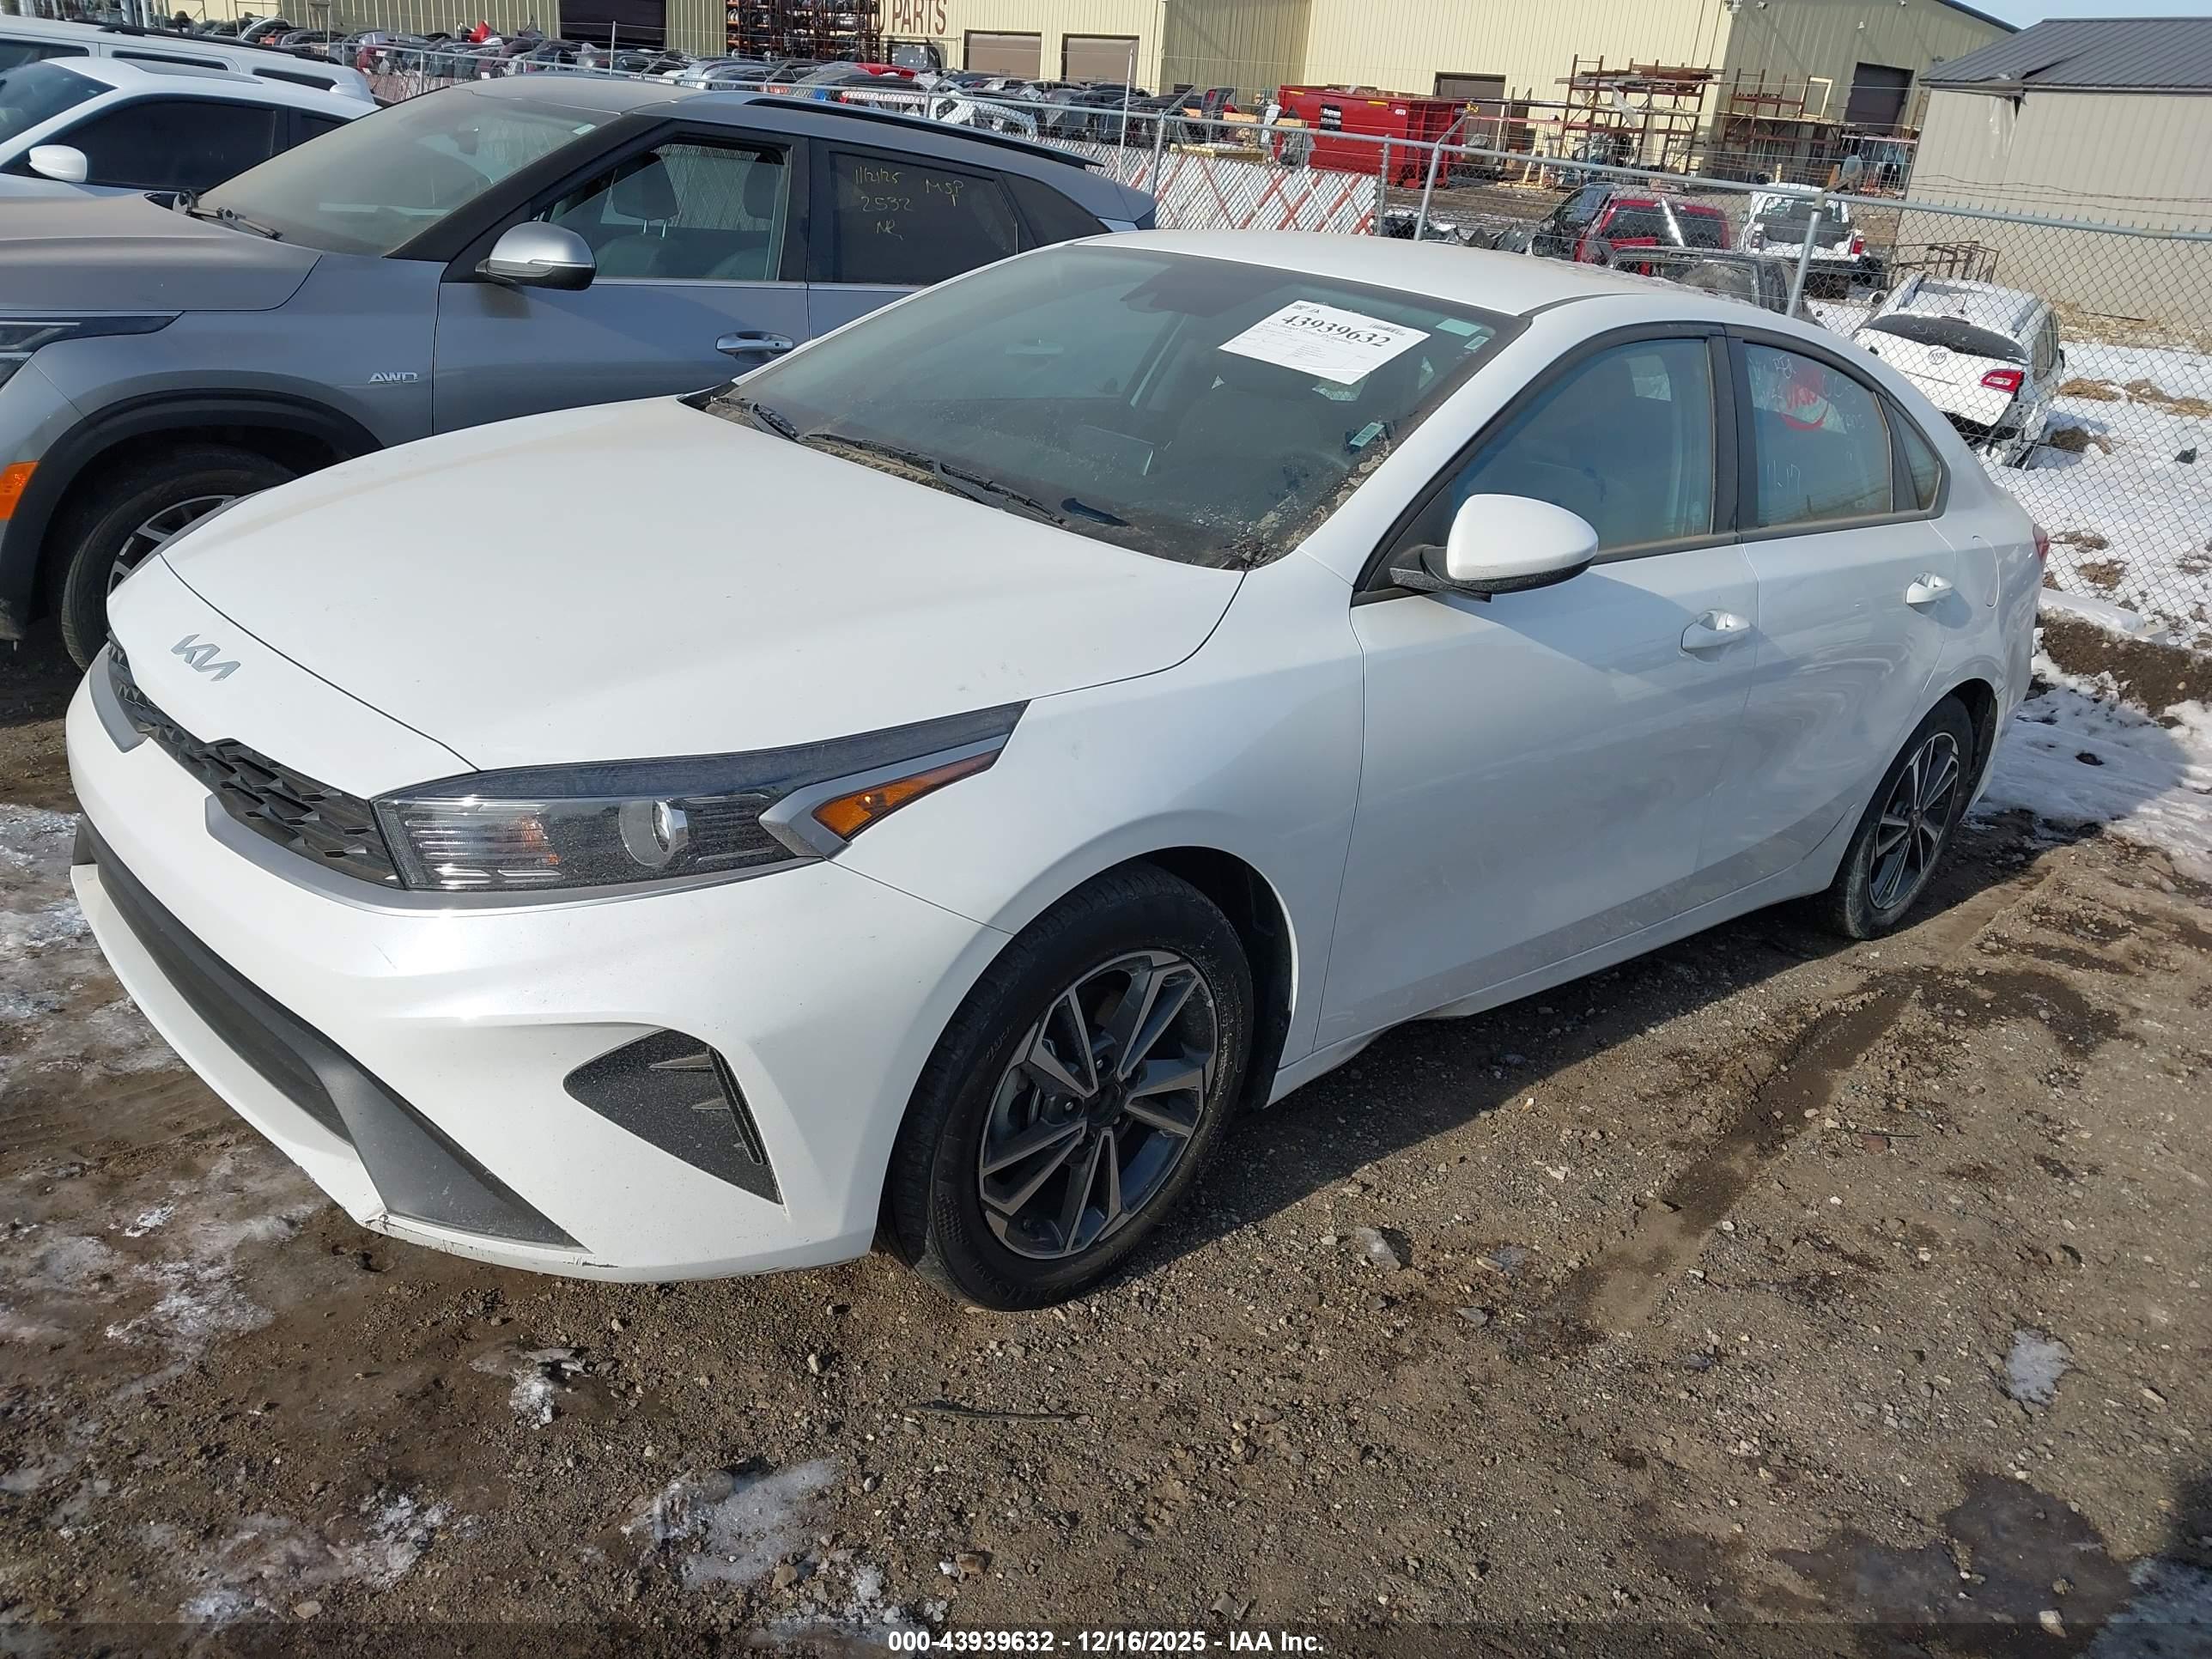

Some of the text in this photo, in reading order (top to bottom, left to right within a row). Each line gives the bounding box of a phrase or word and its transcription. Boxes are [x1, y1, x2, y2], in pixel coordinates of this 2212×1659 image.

[892, 0, 947, 35] PARTS
[860, 196, 914, 212] 2532
[1281, 314, 1391, 348] 43939632
[368, 372, 418, 385] AWD
[170, 634, 241, 682] KIA
